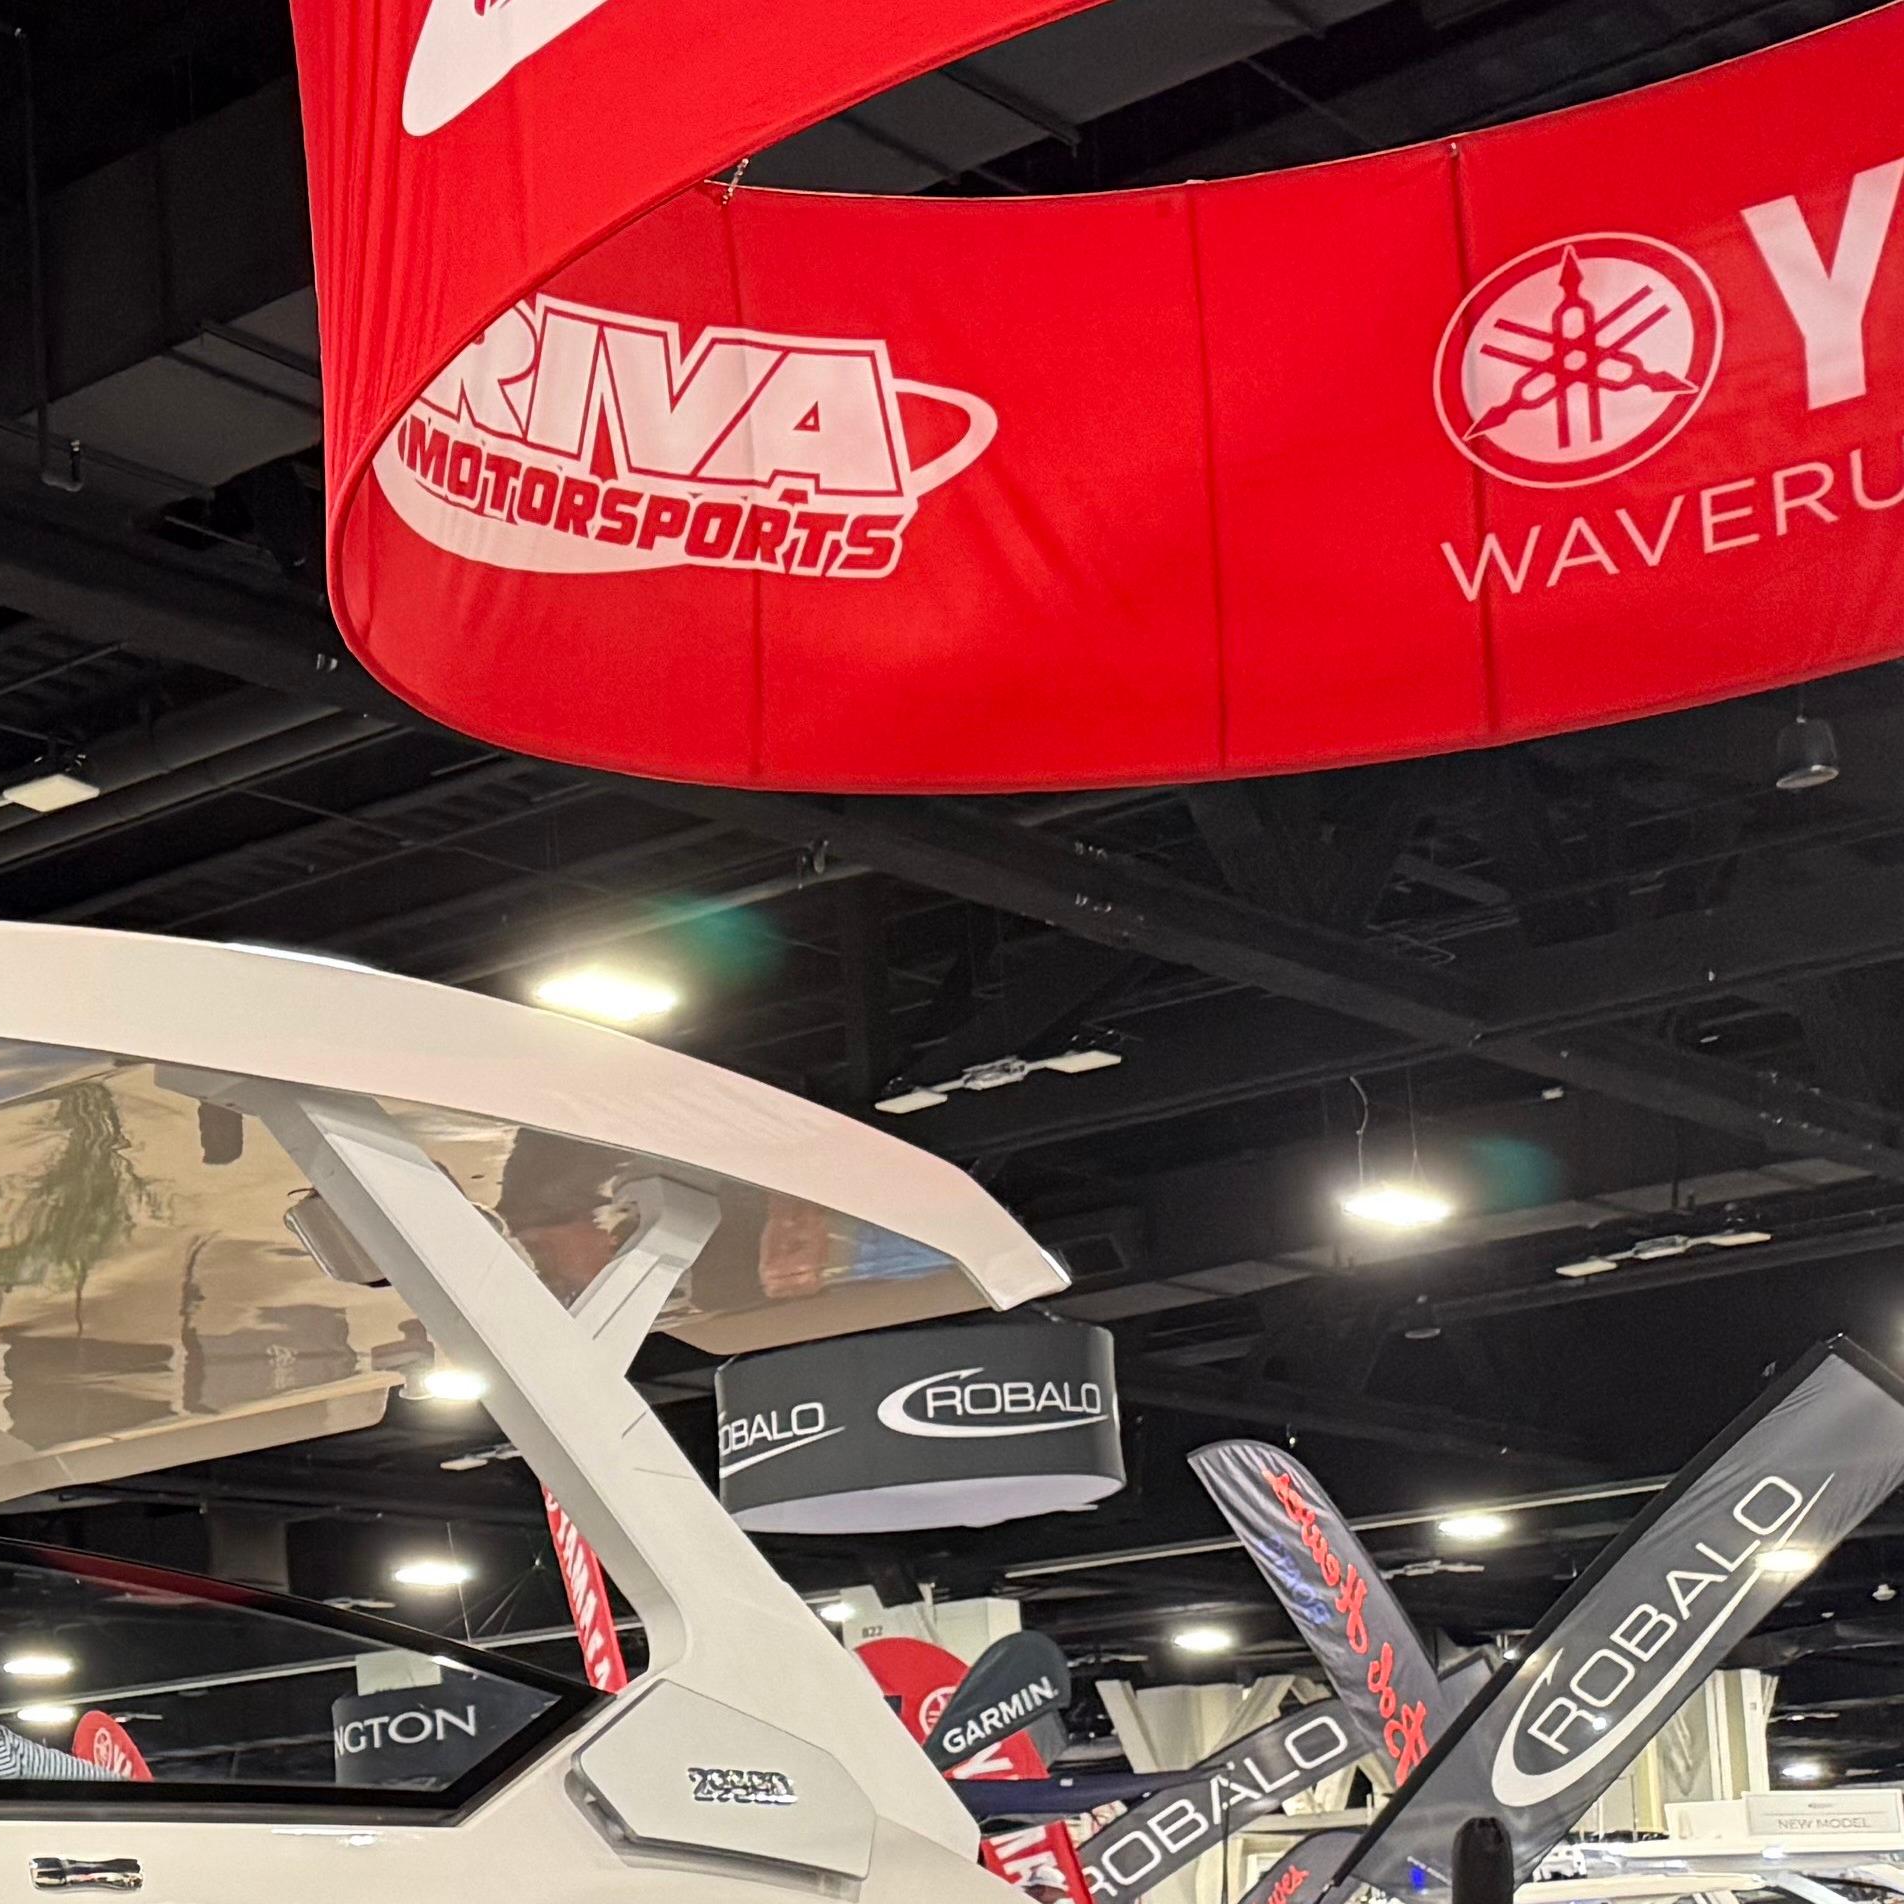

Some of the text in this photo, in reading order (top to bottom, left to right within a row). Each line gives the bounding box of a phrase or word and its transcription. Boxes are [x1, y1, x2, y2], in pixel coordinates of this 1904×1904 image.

[420, 296, 904, 498] RIVA
[405, 423, 905, 573] MOTORSPORTS
[720, 1401, 826, 1456] OBALO
[926, 1382, 1102, 1419] ROBALO
[1528, 1476, 1804, 1755] ROBALO
[942, 1677, 1055, 1754] GARMIN
[1778, 1816, 1872, 1830] NEW MODEL
